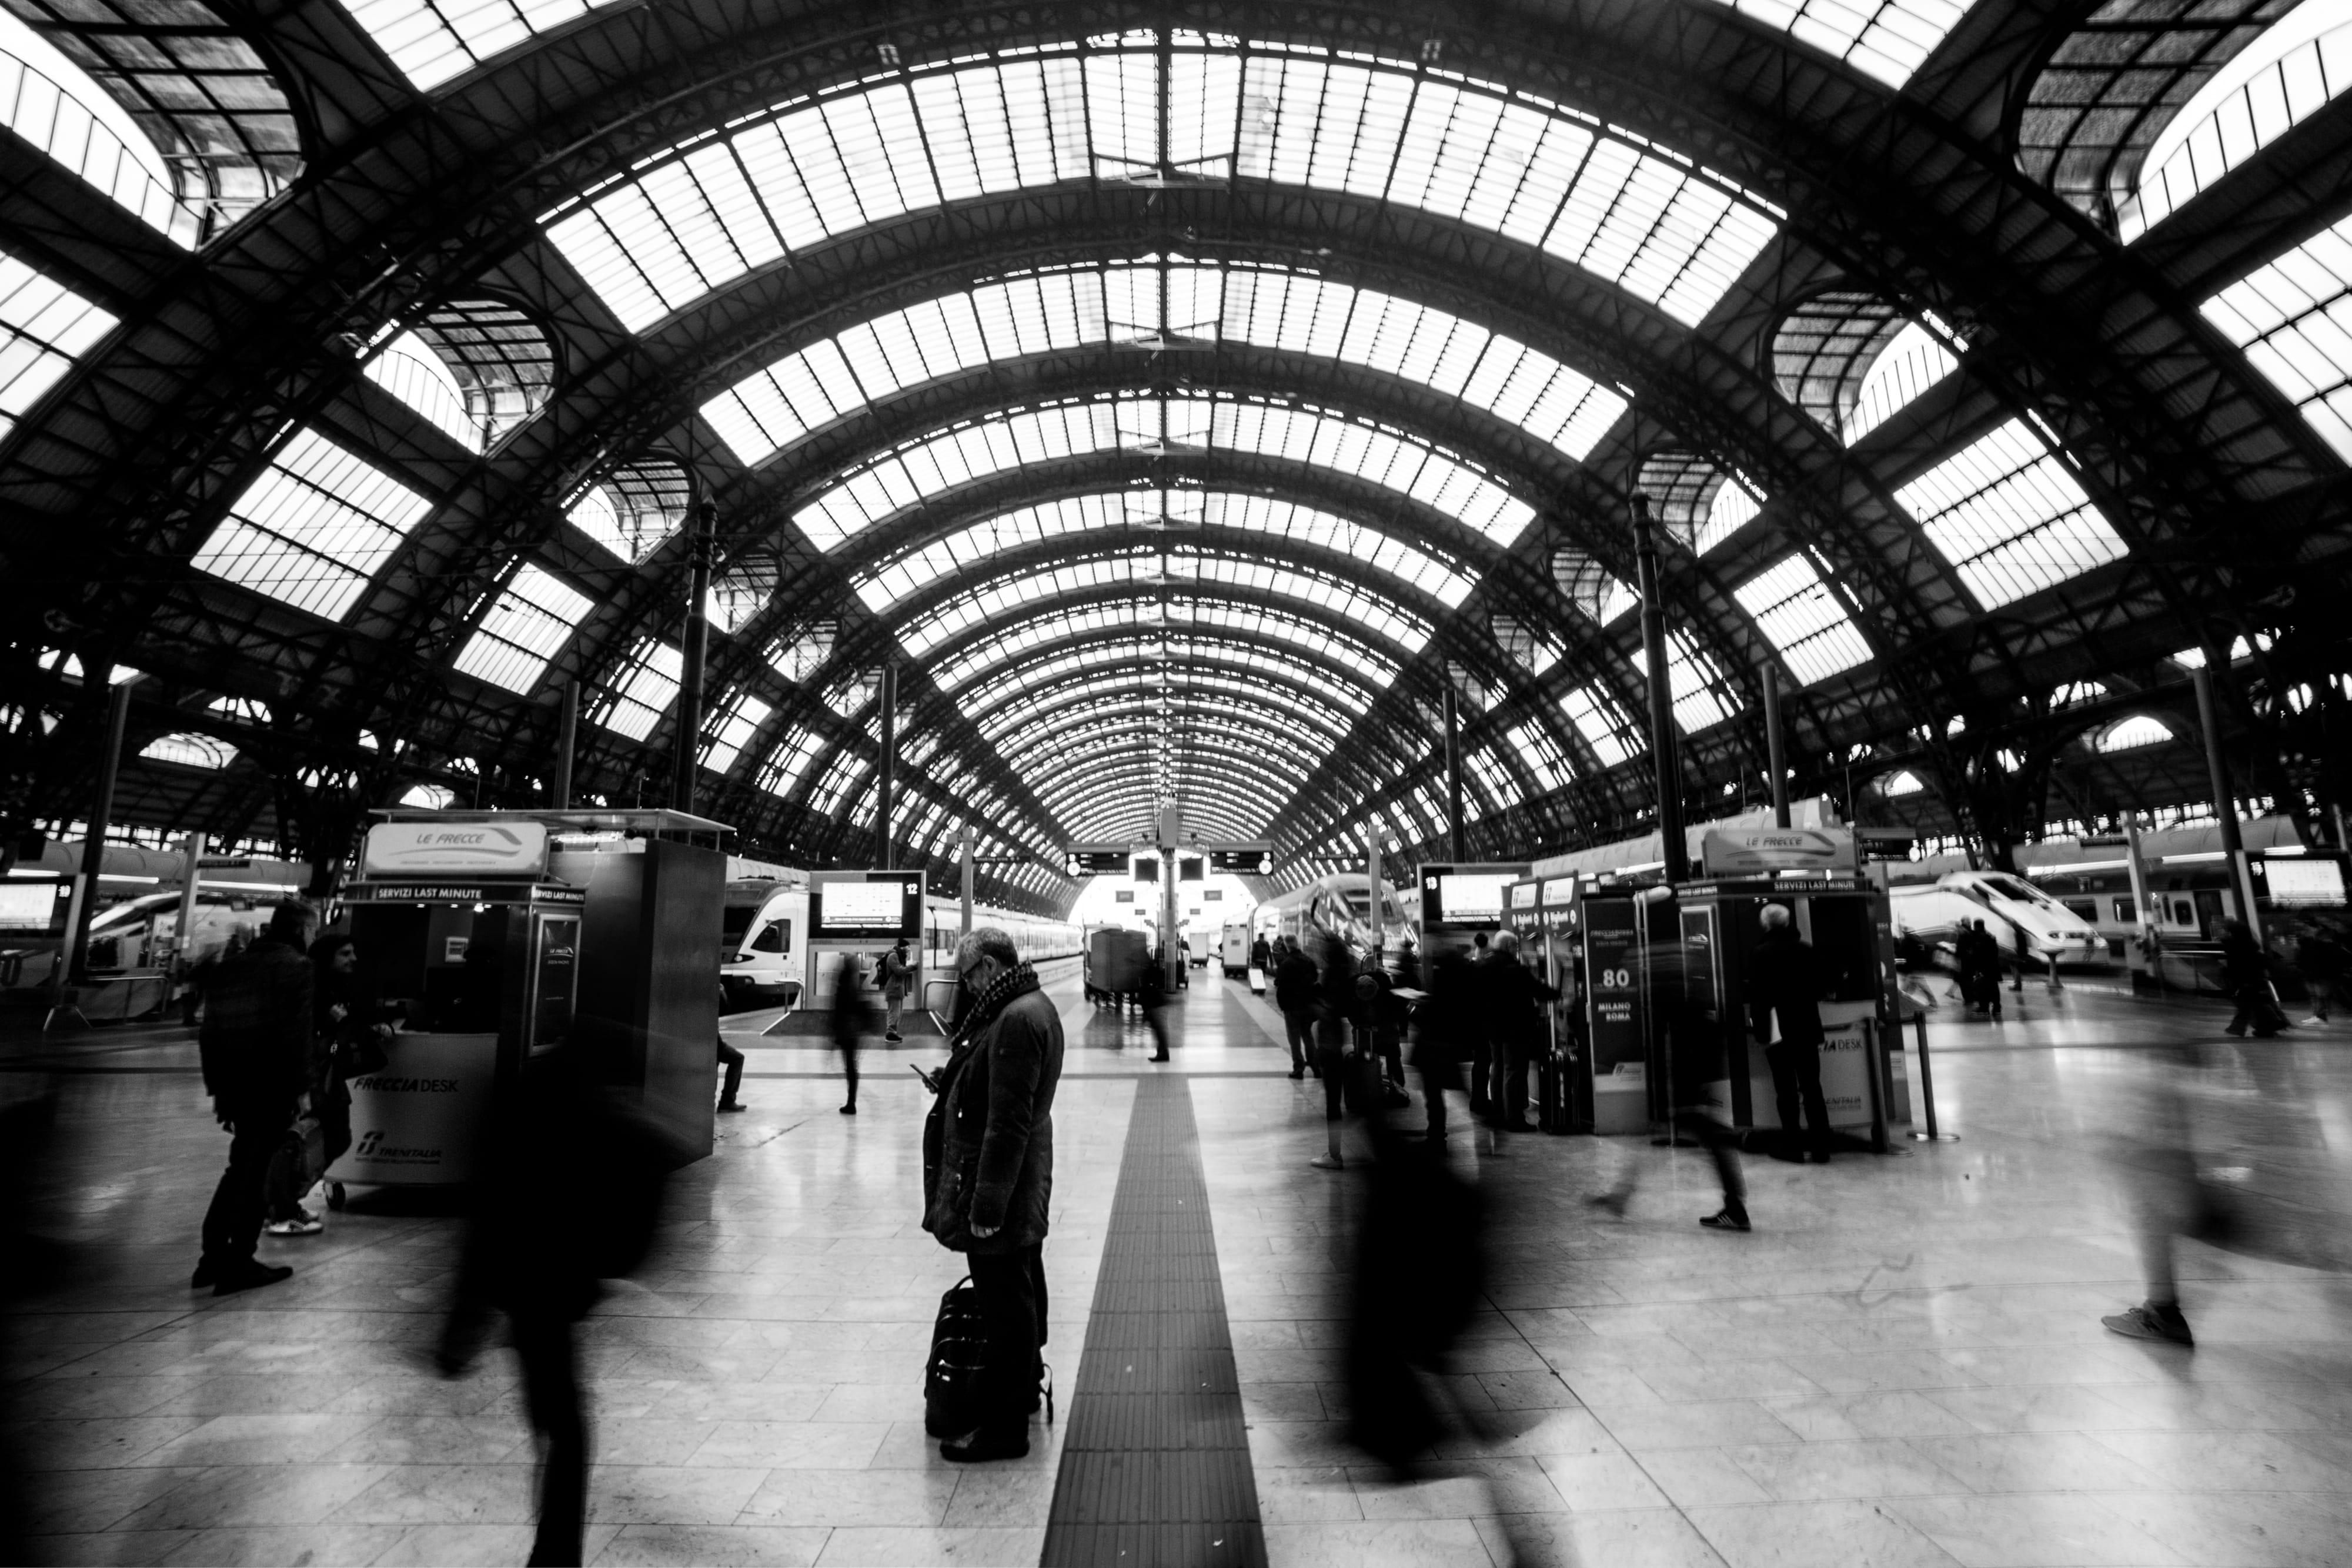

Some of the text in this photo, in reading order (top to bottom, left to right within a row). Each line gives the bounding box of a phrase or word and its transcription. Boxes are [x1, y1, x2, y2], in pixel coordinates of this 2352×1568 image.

[417, 833, 485, 844] LE FRECCE
[1746, 837, 1803, 845] LE FRECCE
[906, 883, 918, 894] 12
[1774, 880, 1855, 890] SERVIZI LAST MINUTE
[378, 888, 482, 899] SERVIZI LAST MINUTE
[553, 891, 565, 900] LAST
[566, 892, 584, 901] MINUTE
[1603, 969, 1629, 988] 80
[1598, 1002, 1631, 1012] MILANO
[1606, 1012, 1631, 1022] ROMA
[379, 1148, 442, 1158] TRENITALIA
